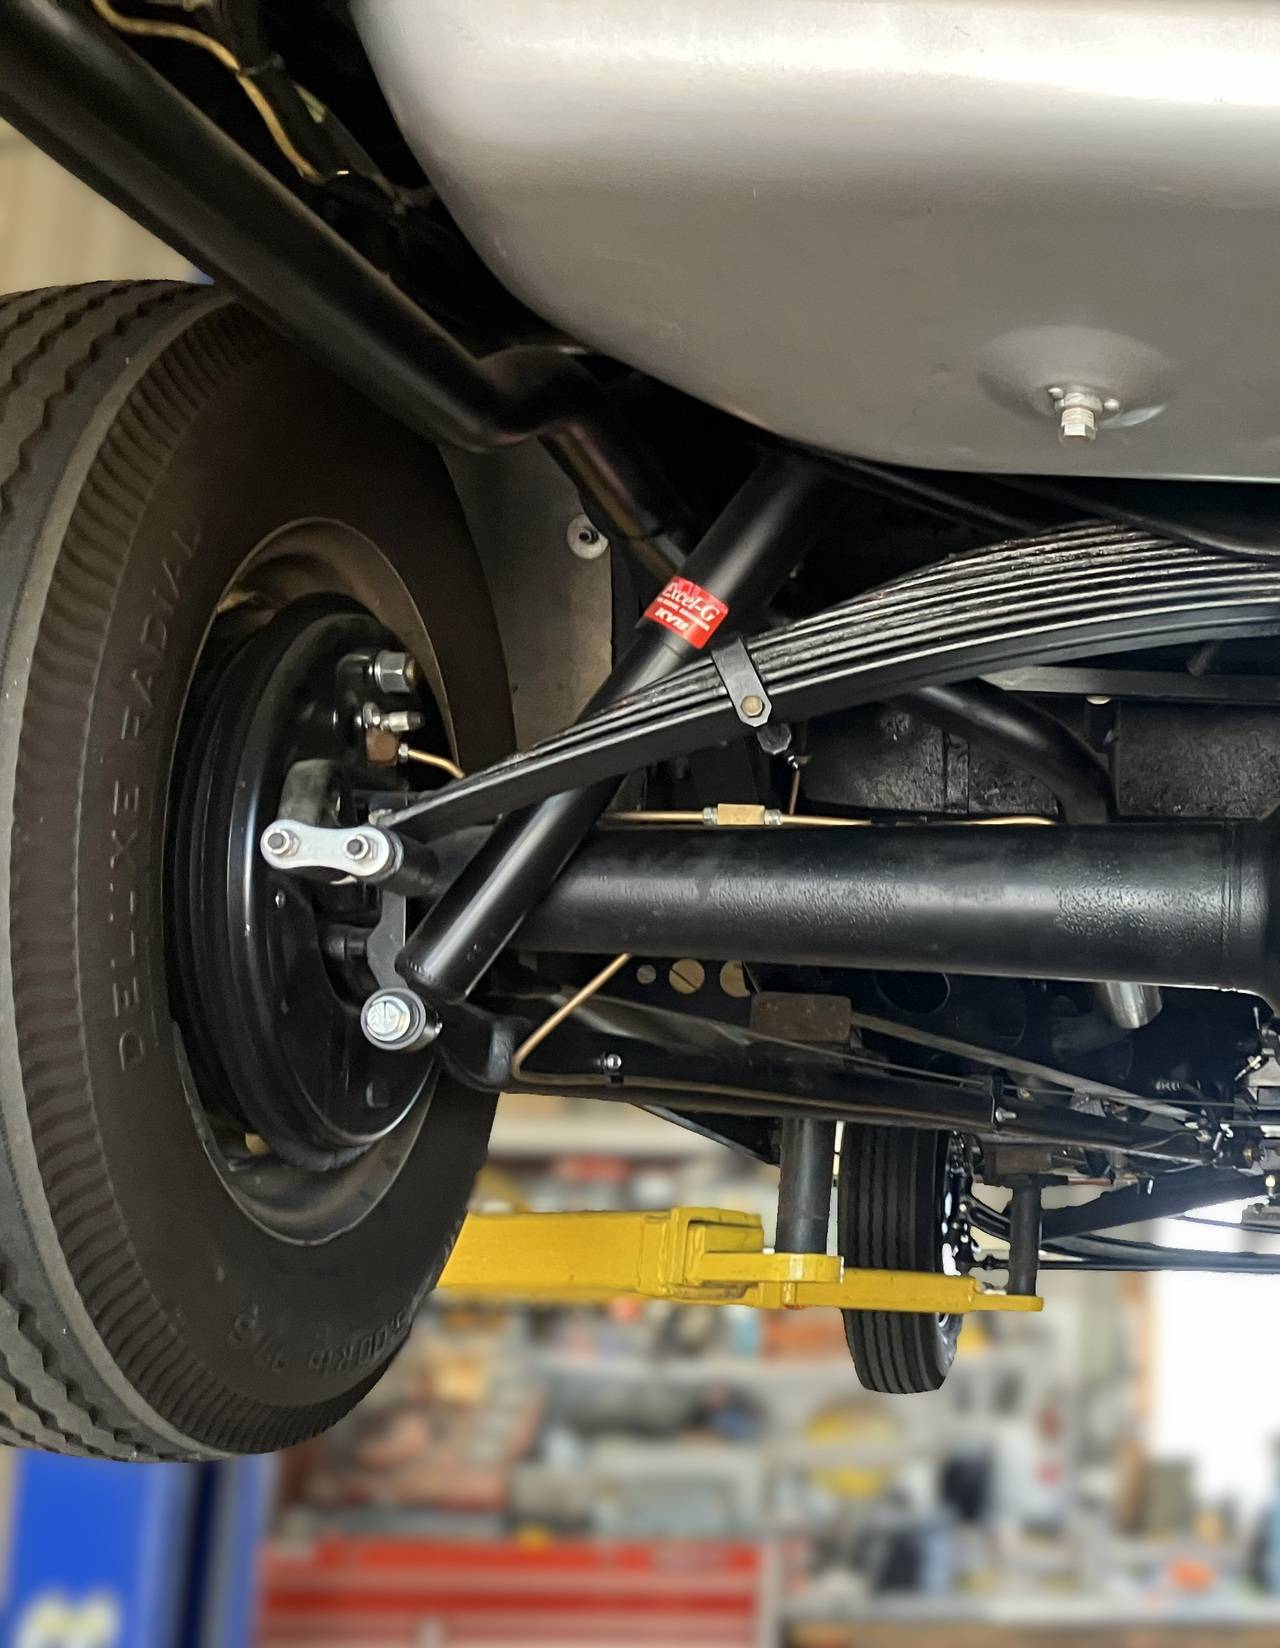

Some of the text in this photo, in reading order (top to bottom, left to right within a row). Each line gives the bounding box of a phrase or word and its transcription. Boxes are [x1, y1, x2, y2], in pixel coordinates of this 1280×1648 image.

[661, 582, 720, 622] Excel-G
[109, 529, 200, 1072] DELUXE RADIAL
